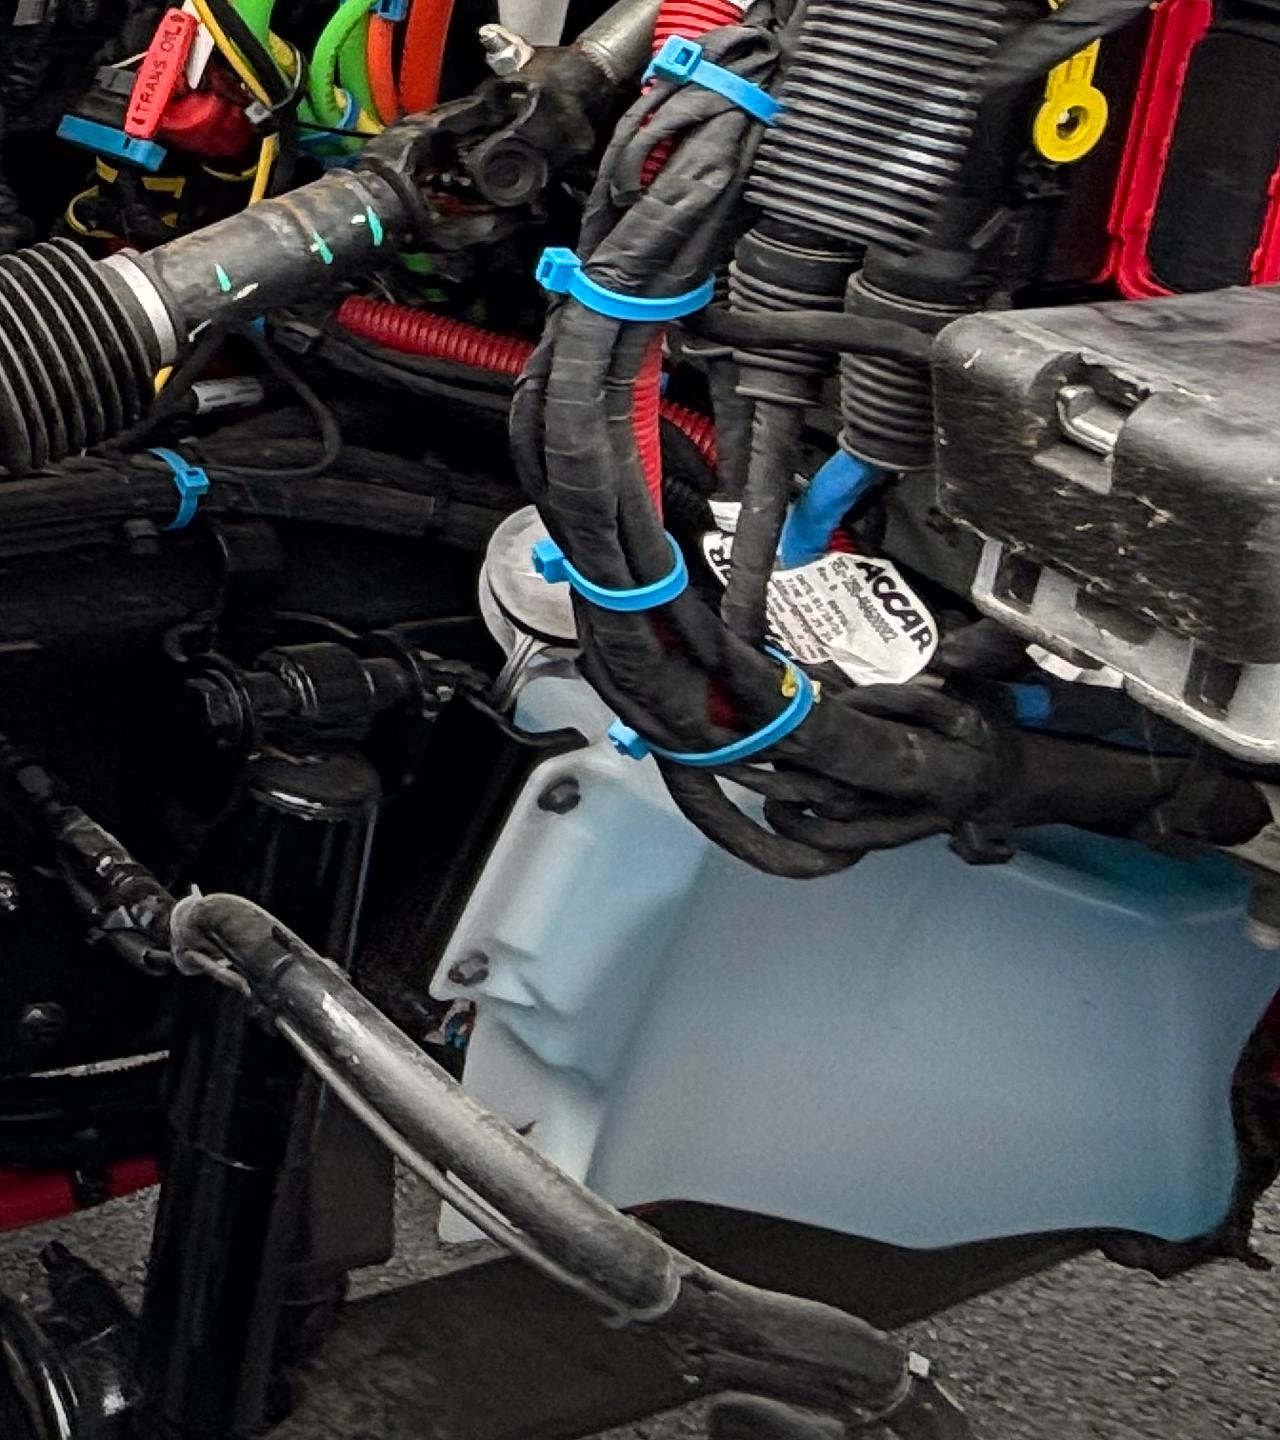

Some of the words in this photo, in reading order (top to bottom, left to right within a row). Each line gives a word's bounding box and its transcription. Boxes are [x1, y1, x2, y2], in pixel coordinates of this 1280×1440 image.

[135, 60, 168, 113] TRANS
[160, 25, 183, 53] OIL
[854, 560, 934, 655] ACCAR
